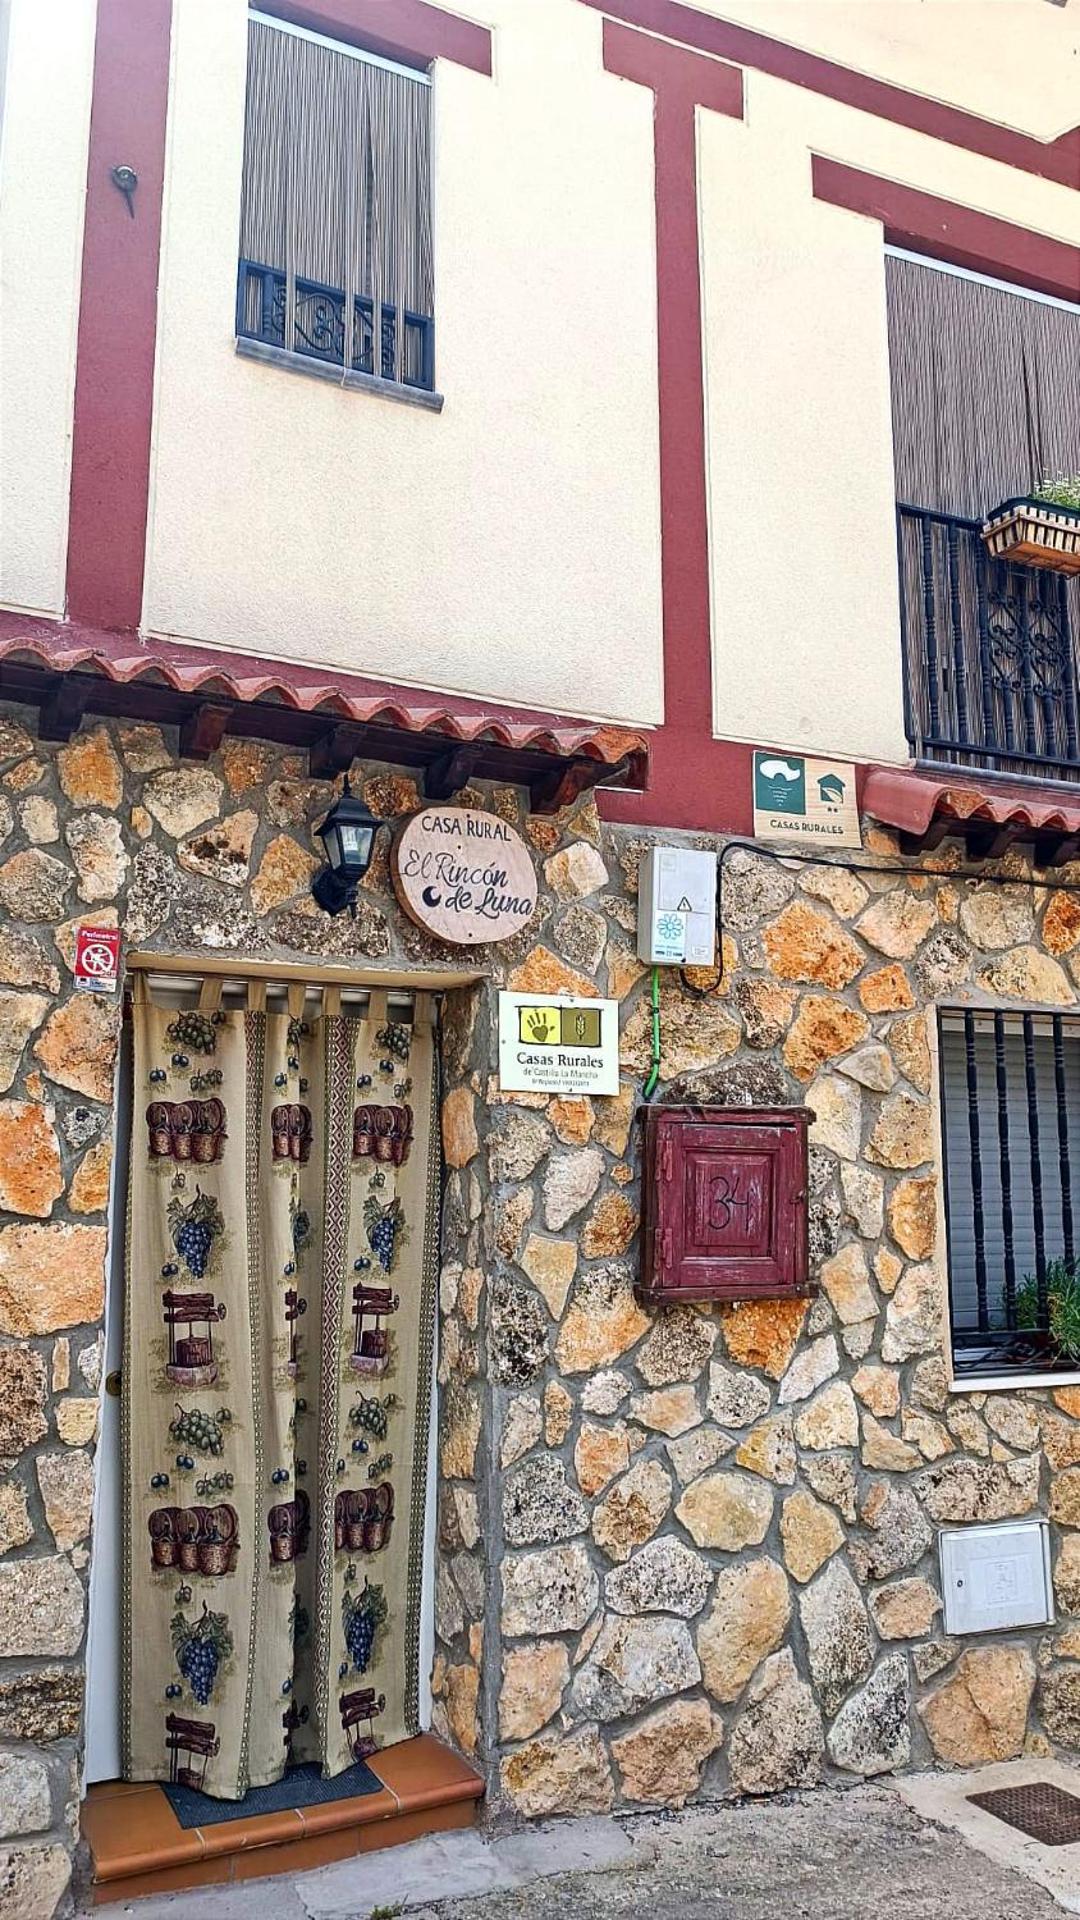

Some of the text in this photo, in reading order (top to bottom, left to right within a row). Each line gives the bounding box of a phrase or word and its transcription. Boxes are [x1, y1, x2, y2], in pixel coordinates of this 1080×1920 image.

[421, 815, 512, 842] CASA RURAL
[769, 819, 844, 835] CASAS RURALES
[401, 849, 509, 888] El Rincón
[445, 885, 534, 920] de Luna
[516, 1051, 604, 1069] Casas Rurales
[522, 1067, 532, 1076] de
[708, 1176, 750, 1233] 34
